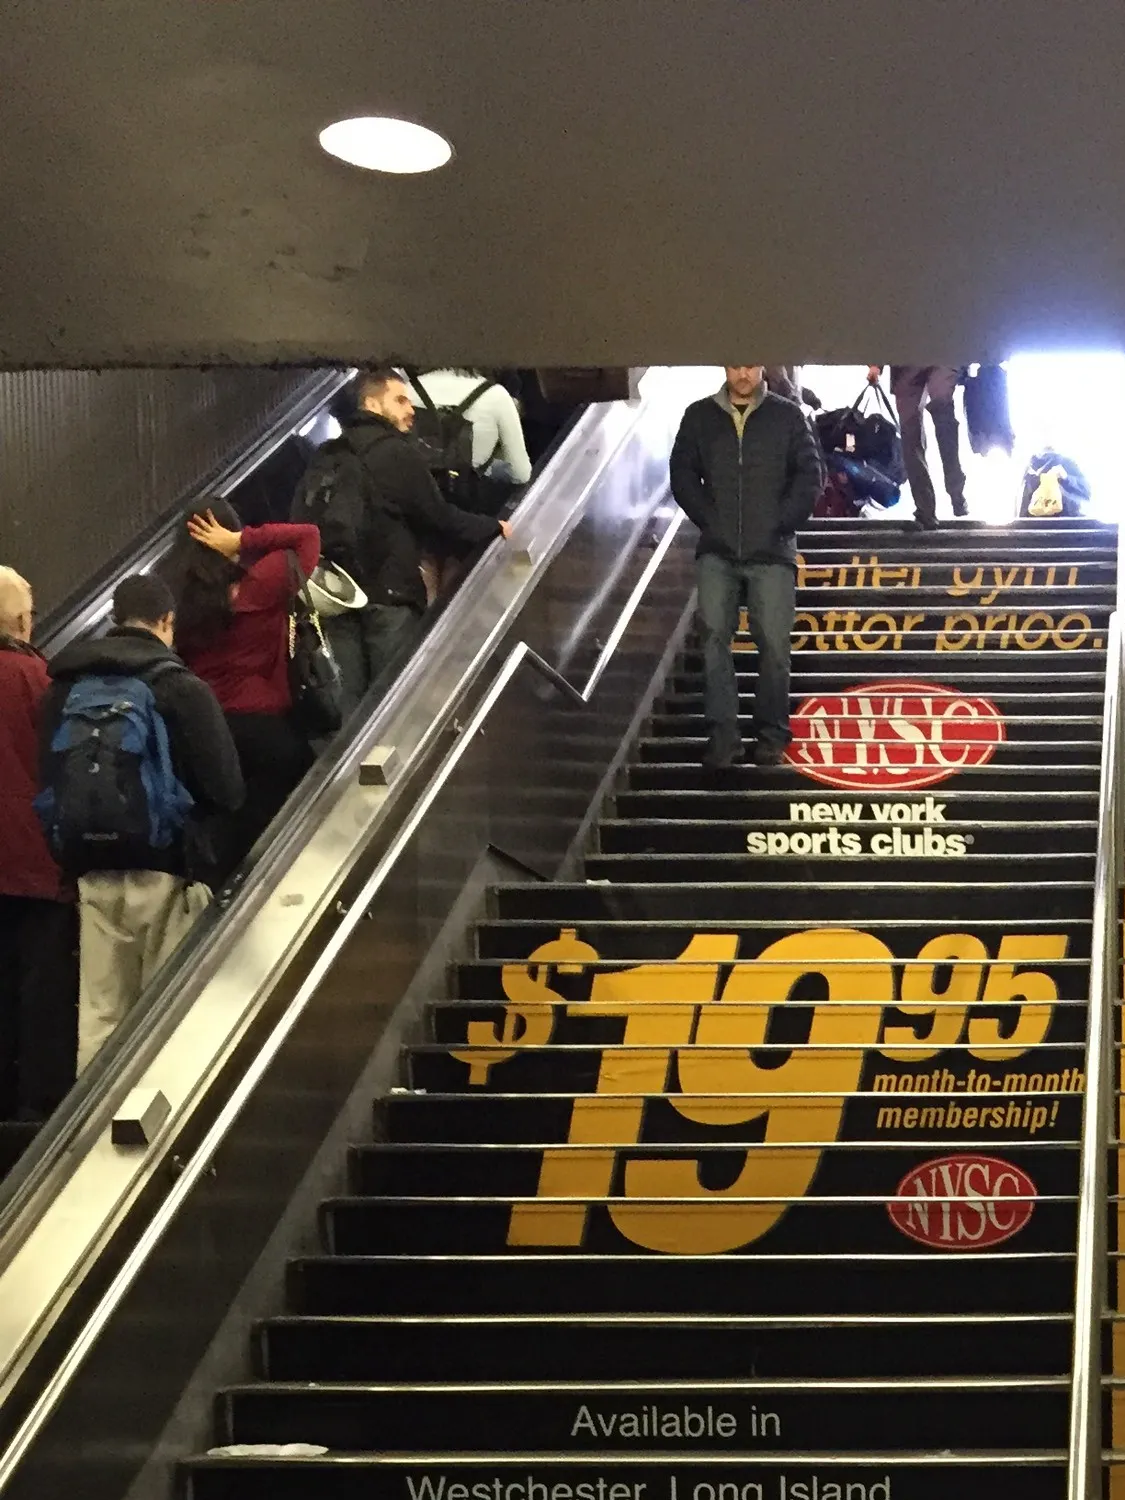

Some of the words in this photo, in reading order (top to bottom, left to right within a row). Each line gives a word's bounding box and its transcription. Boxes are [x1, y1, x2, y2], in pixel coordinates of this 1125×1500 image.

[935, 610, 1102, 652] price.
[797, 697, 980, 776] NYSC
[790, 801, 863, 822] new
[871, 797, 946, 822] york
[747, 827, 862, 856] sports
[876, 1100, 1060, 1134] membership!
[907, 1162, 1021, 1242] NYSC
[571, 1405, 737, 1438] Available
[752, 1405, 781, 1438] in
